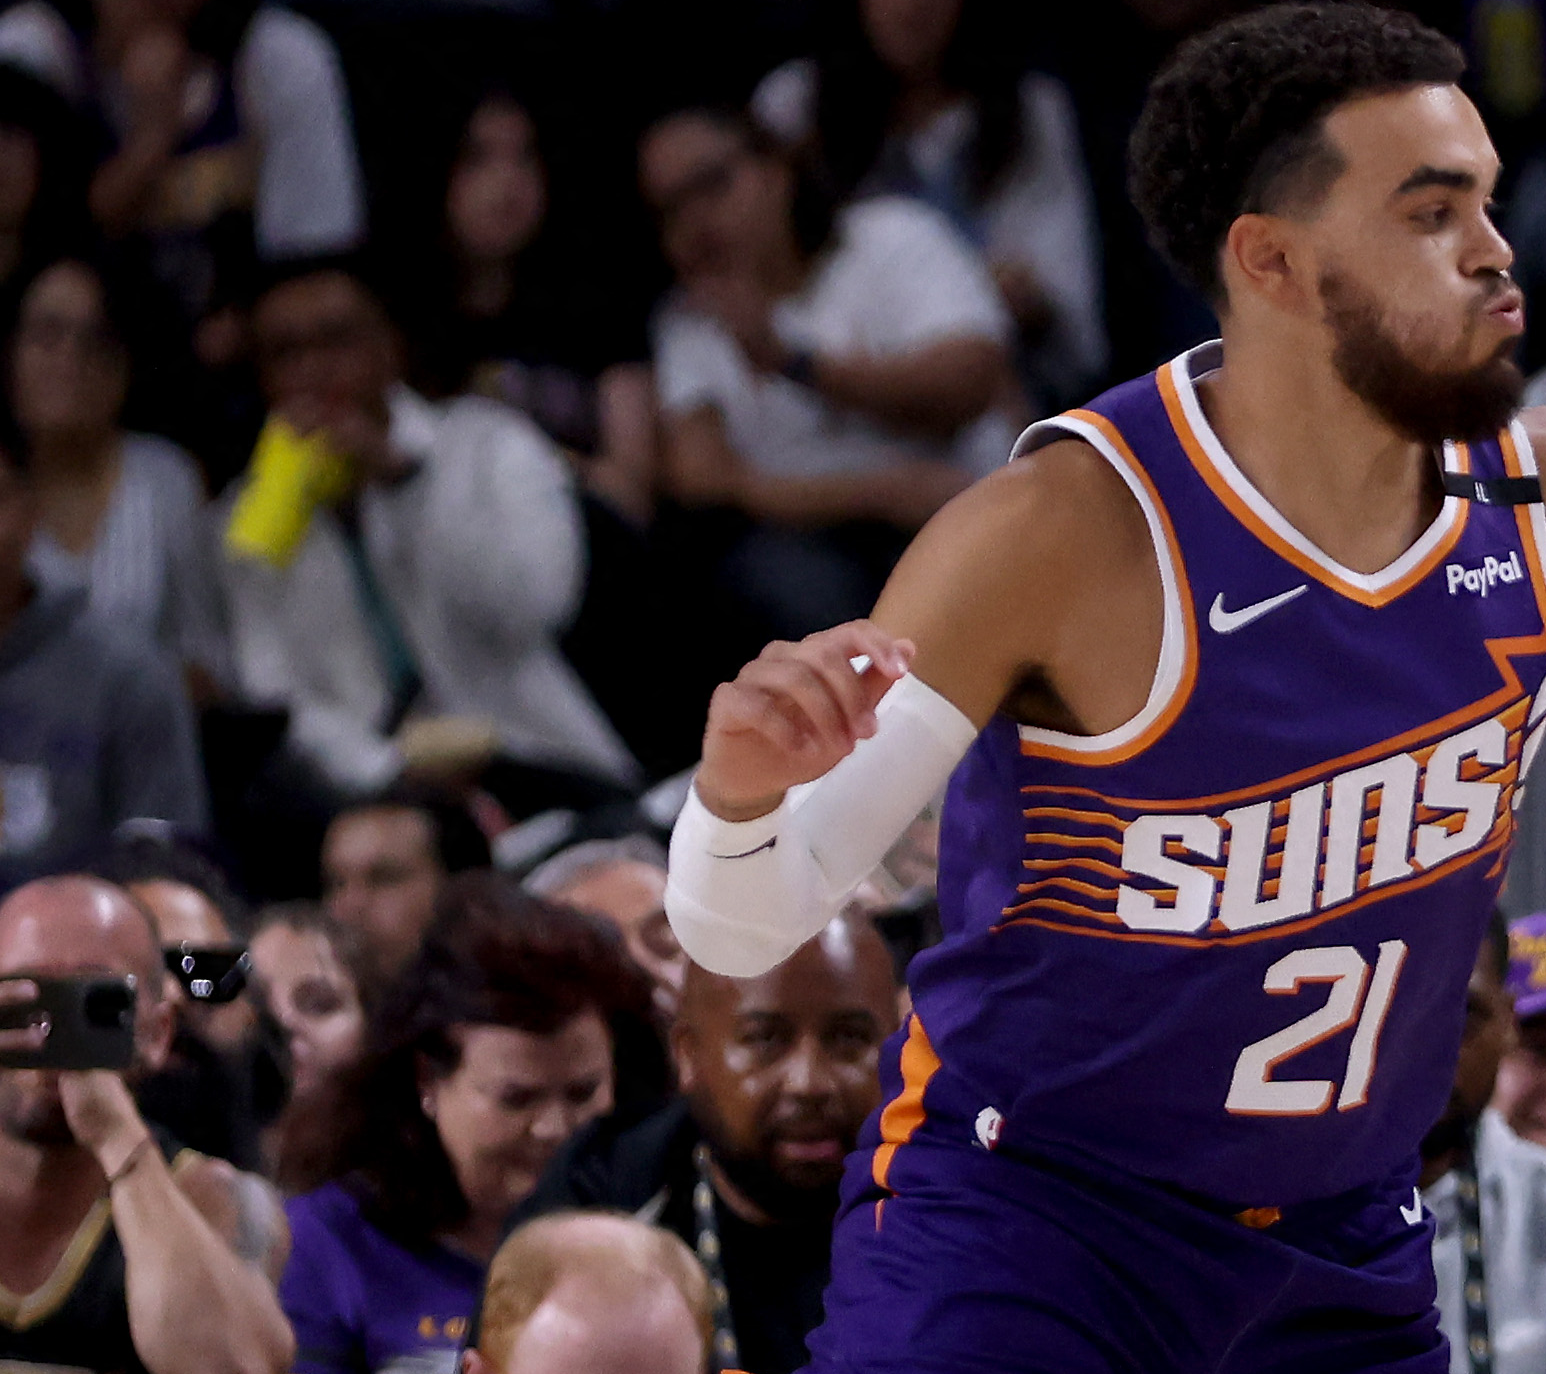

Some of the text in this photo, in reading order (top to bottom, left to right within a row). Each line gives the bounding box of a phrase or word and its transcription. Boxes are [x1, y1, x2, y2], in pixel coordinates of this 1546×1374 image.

[1445, 550, 1524, 598] PayPal
[1116, 718, 1507, 934] SUNS
[1225, 940, 1409, 1116] 21
